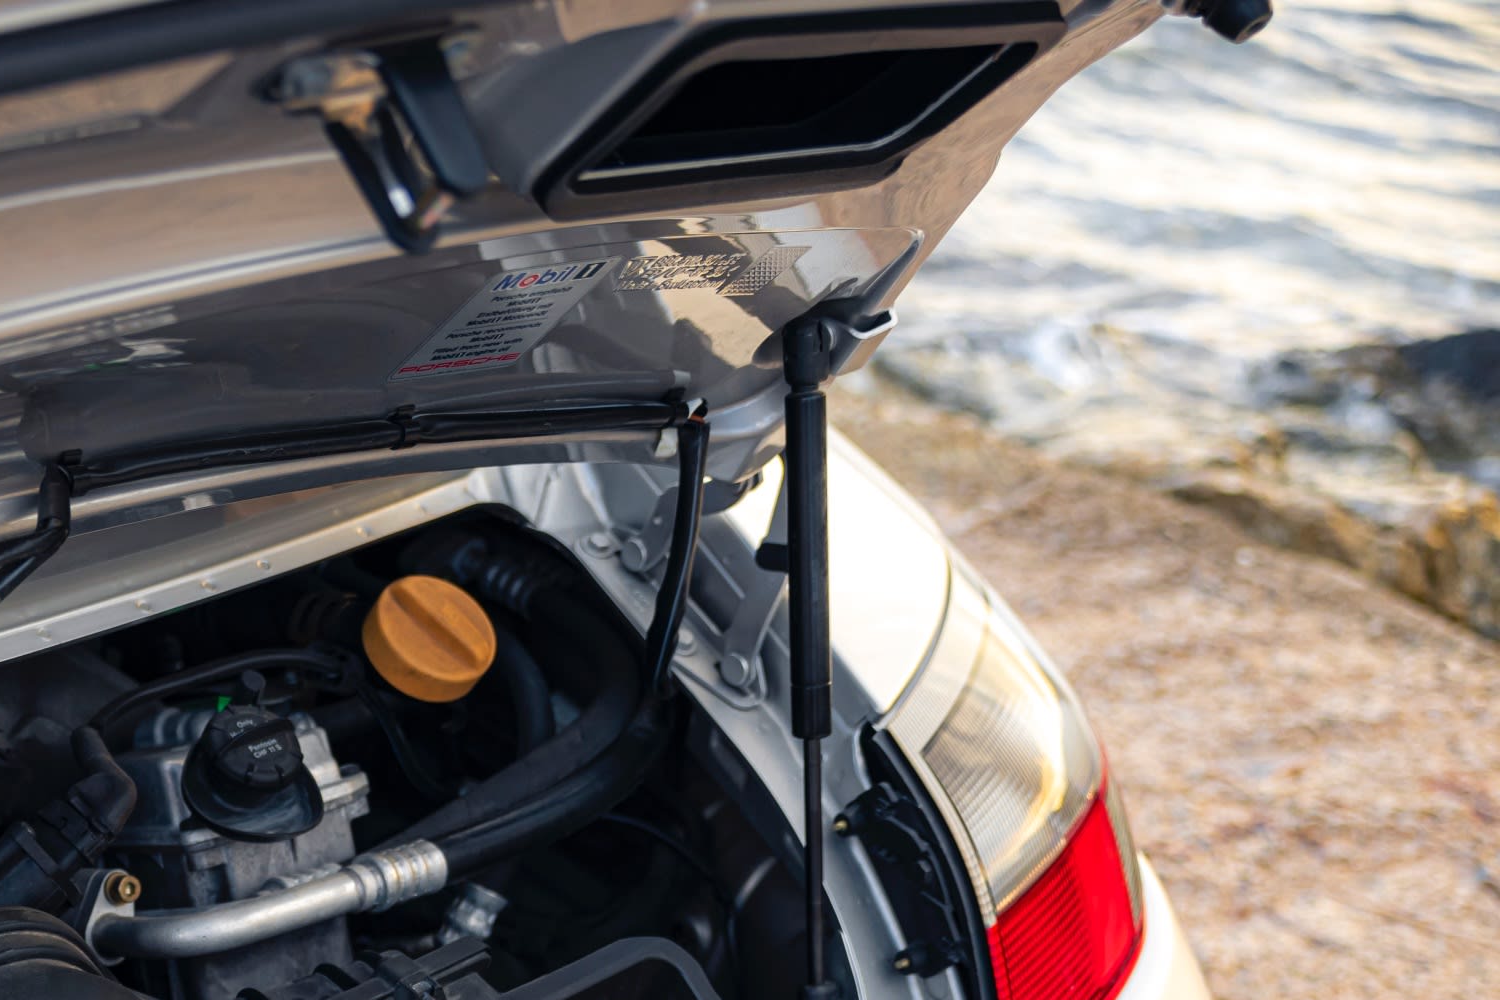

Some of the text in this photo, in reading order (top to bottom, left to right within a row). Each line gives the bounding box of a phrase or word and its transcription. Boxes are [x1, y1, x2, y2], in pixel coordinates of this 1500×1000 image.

[492, 265, 577, 291] Mobil
[490, 293, 527, 302] Porsche
[445, 330, 482, 339] Porsche
[398, 353, 521, 374] PORSCHE
